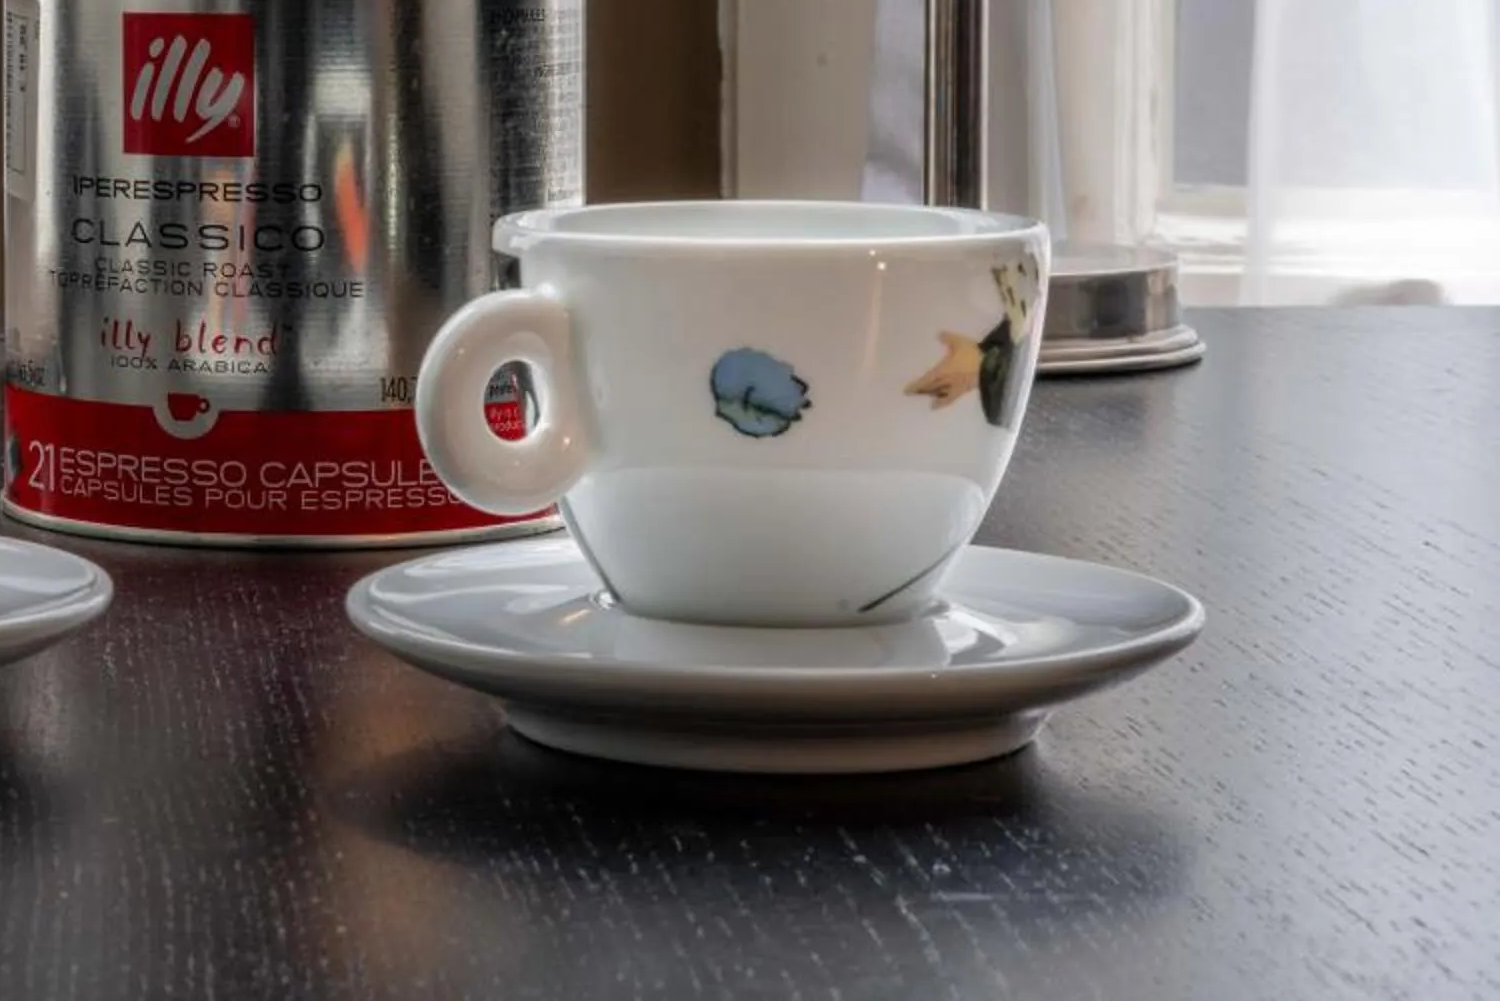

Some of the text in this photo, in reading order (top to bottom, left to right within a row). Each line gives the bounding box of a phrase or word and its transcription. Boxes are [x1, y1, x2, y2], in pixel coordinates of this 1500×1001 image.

[130, 34, 246, 144] illy
[73, 174, 323, 202] IPERESPRESSO
[71, 218, 326, 251] CLASSICO
[94, 256, 289, 281] CLASSIC ROAST
[214, 280, 366, 299] CLASSIQUE
[100, 316, 150, 357] illy
[110, 355, 270, 374] 100% ARABICA
[28, 440, 56, 492] 21
[59, 447, 248, 488] ESPRESSO
[60, 475, 194, 507] CAPSULES
[204, 487, 288, 511] POUR
